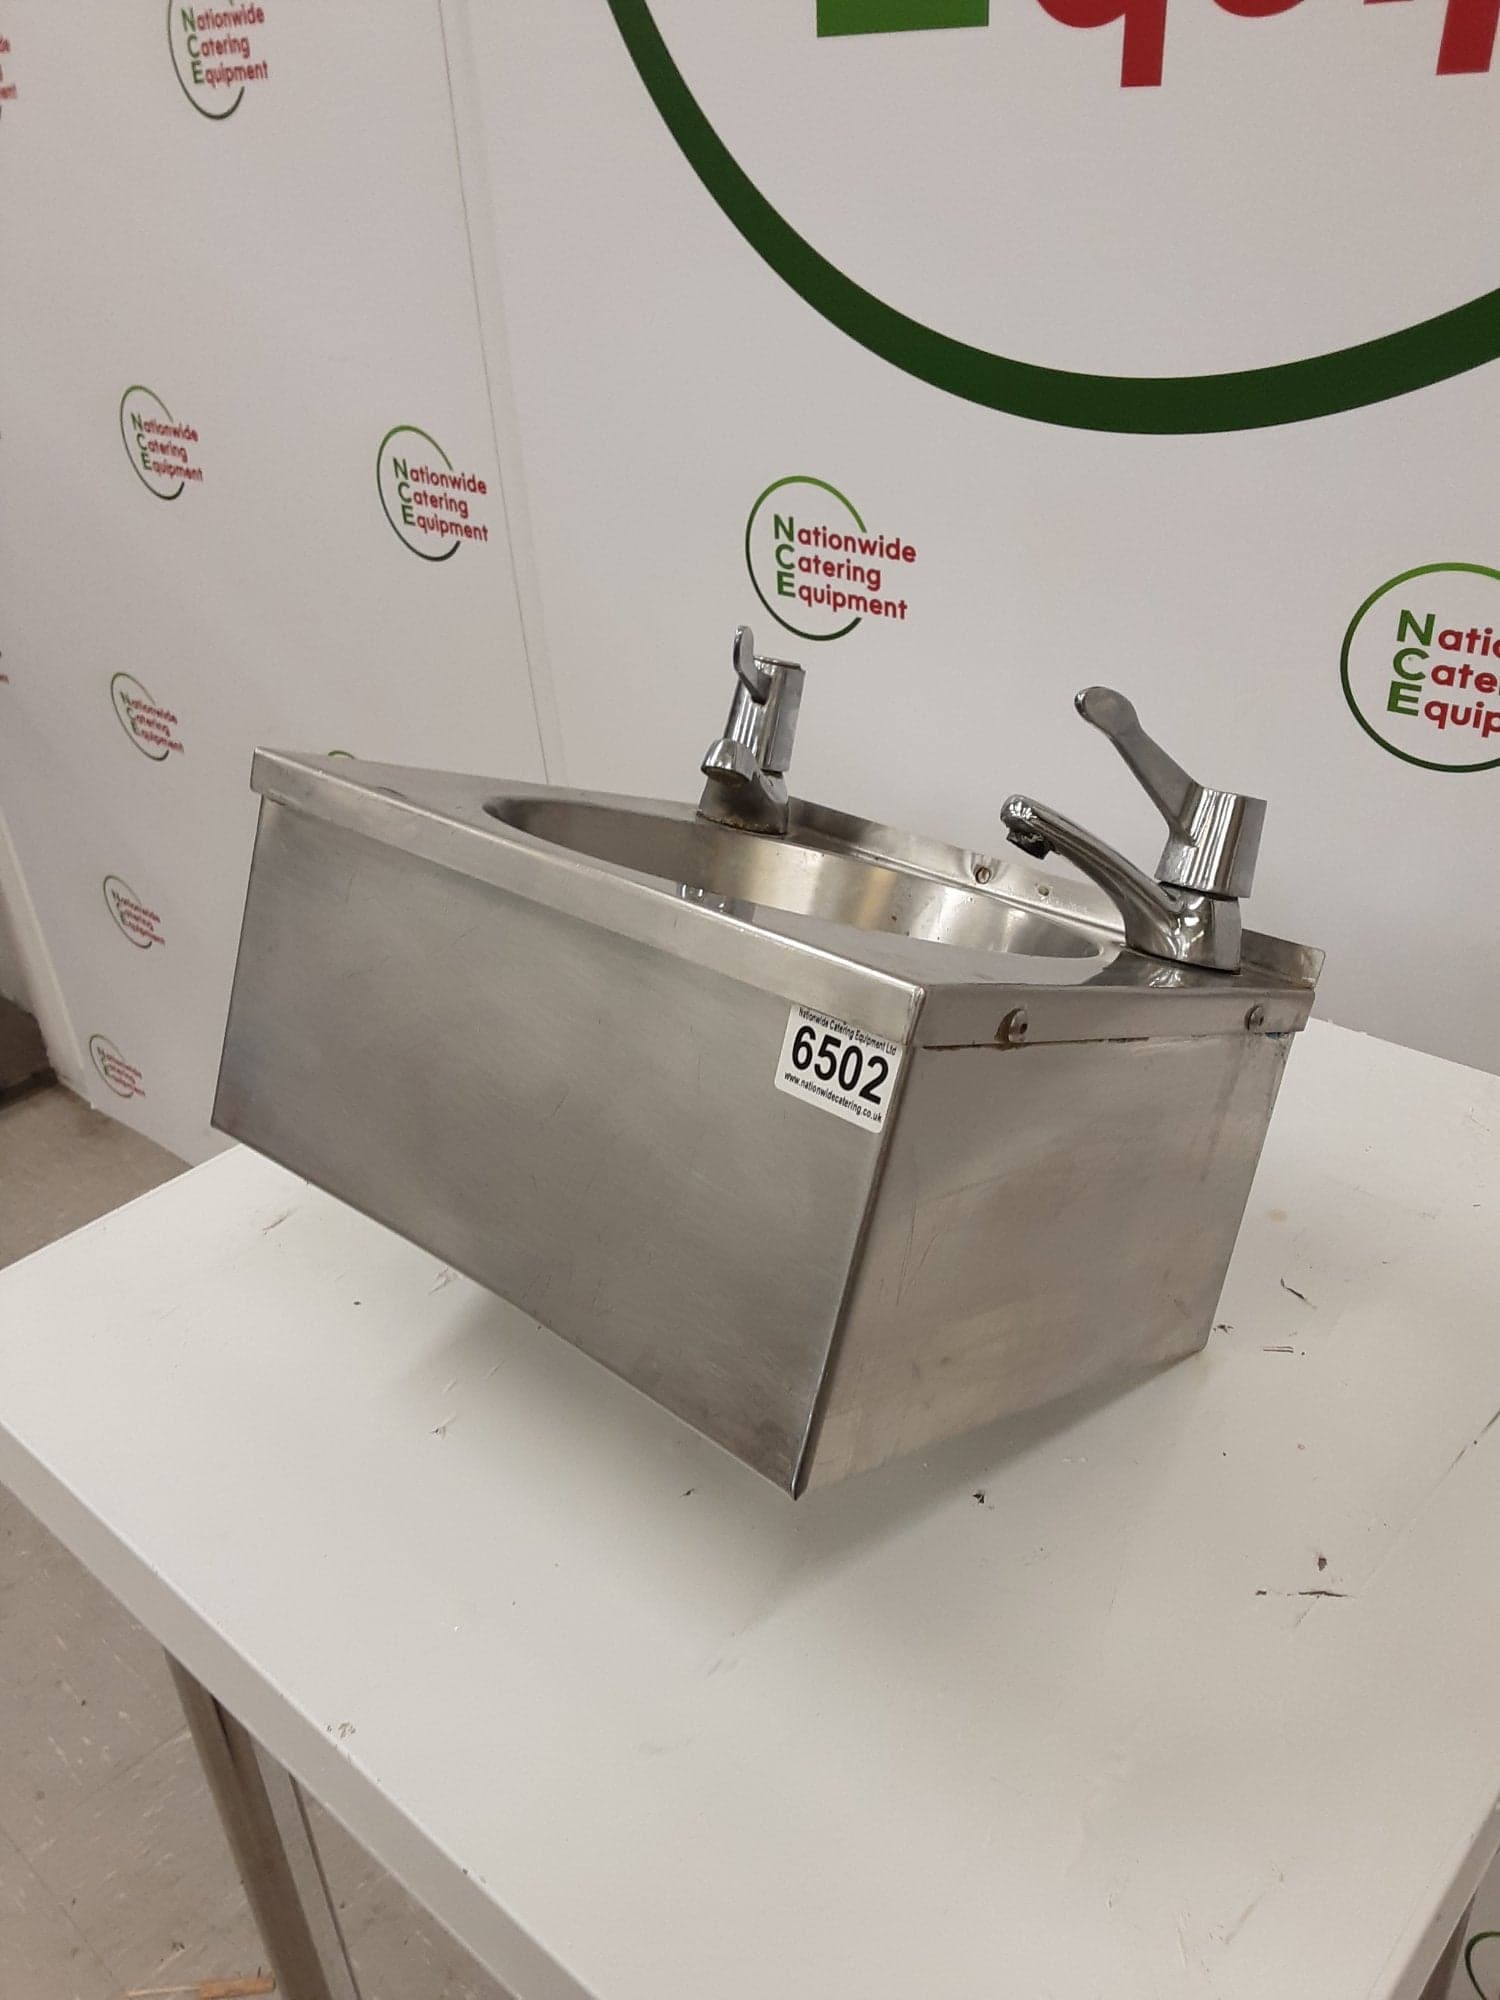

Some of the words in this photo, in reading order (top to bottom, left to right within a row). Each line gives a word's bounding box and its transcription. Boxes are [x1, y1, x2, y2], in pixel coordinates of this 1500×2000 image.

[181, 2, 265, 32] Nationwide
[187, 33, 250, 59] Catering
[191, 59, 268, 88] Equipment
[393, 456, 488, 494] Nationwide
[398, 481, 469, 519] Catering
[401, 503, 488, 541] Equipment
[773, 513, 917, 563] Nationwide
[775, 543, 881, 592] Catering
[776, 570, 908, 620] Equipment
[798, 1006, 829, 1028] Nationwide
[829, 1019, 855, 1041] Catering
[854, 1029, 887, 1051] Equipment
[885, 1041, 898, 1056] Ltd
[792, 1025, 889, 1105] 6502
[784, 1071, 883, 1123] www.nationwidecatering.co.uk
